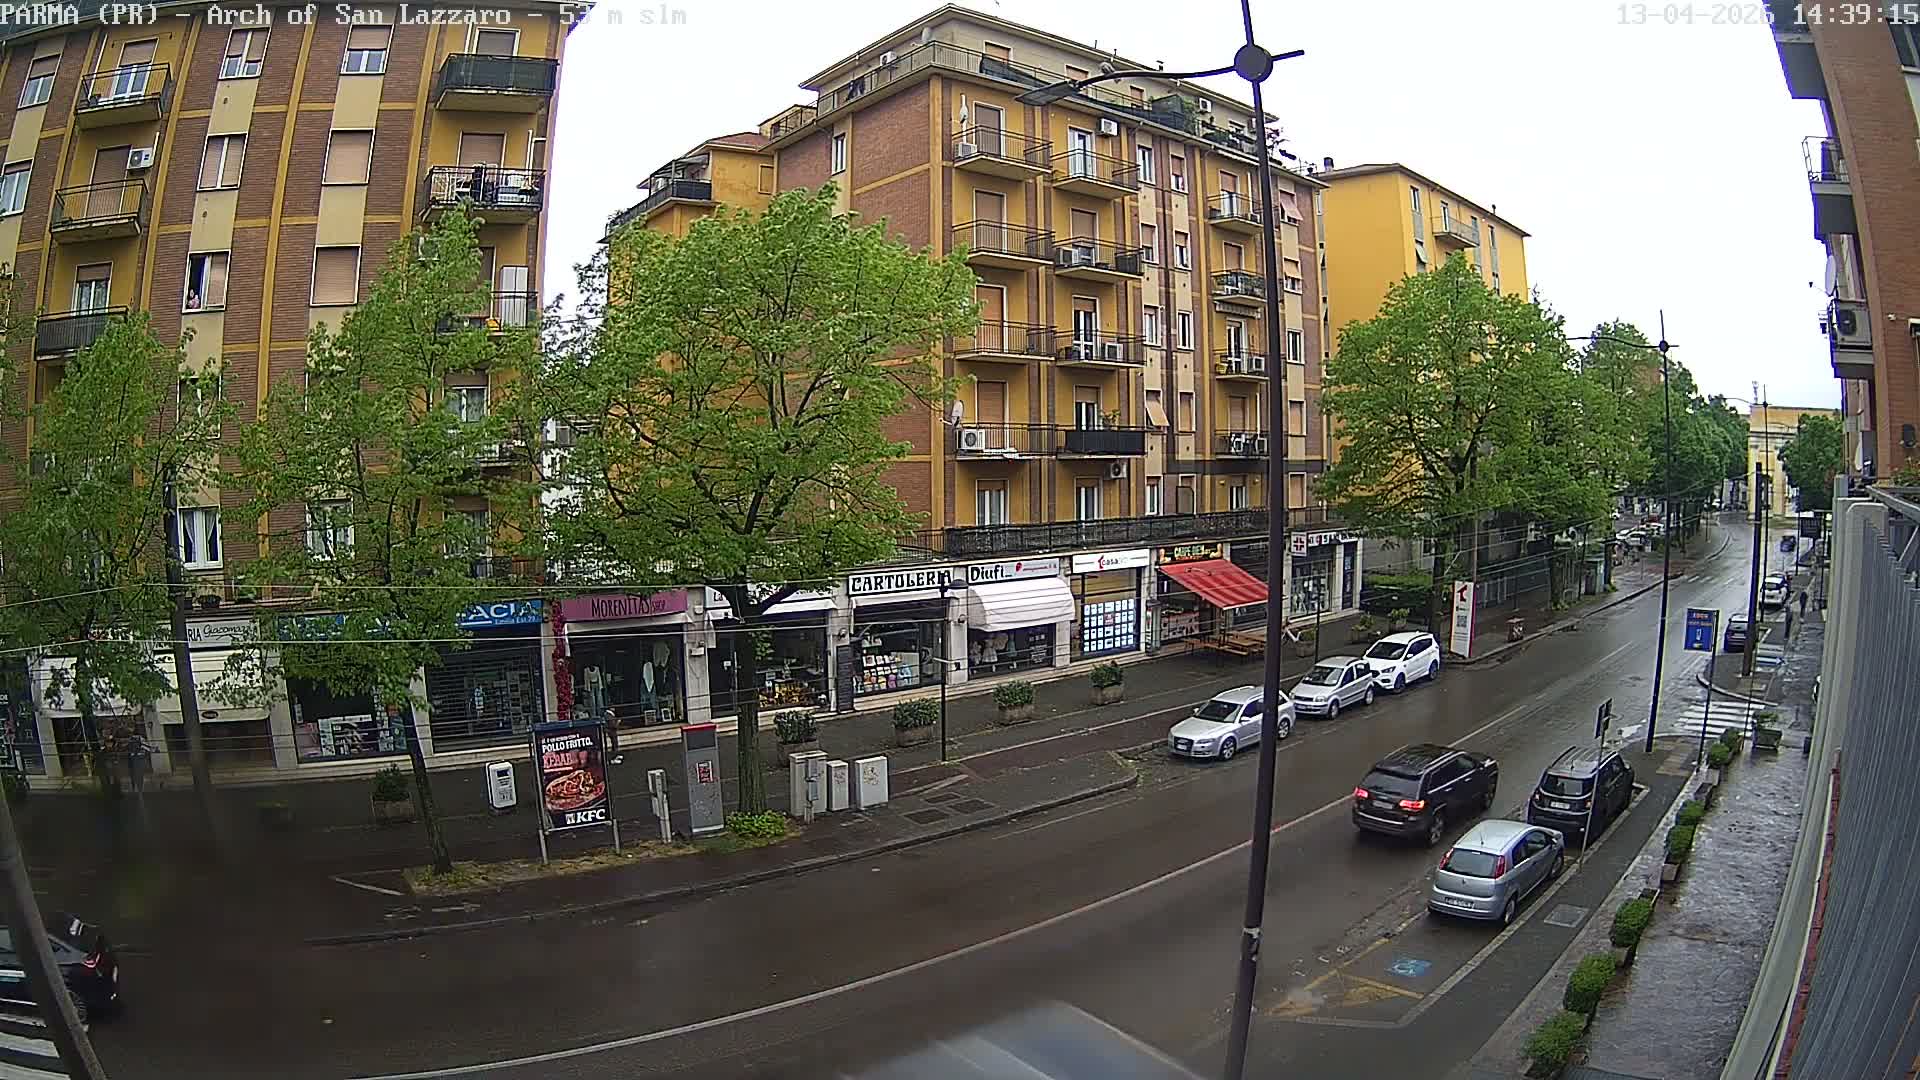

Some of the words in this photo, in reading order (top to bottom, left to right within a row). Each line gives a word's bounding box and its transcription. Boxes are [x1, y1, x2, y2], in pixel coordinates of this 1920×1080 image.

[851, 570, 951, 592] CARTOLERIA
[542, 742, 565, 754] POLLO
[576, 809, 606, 823] KFC
